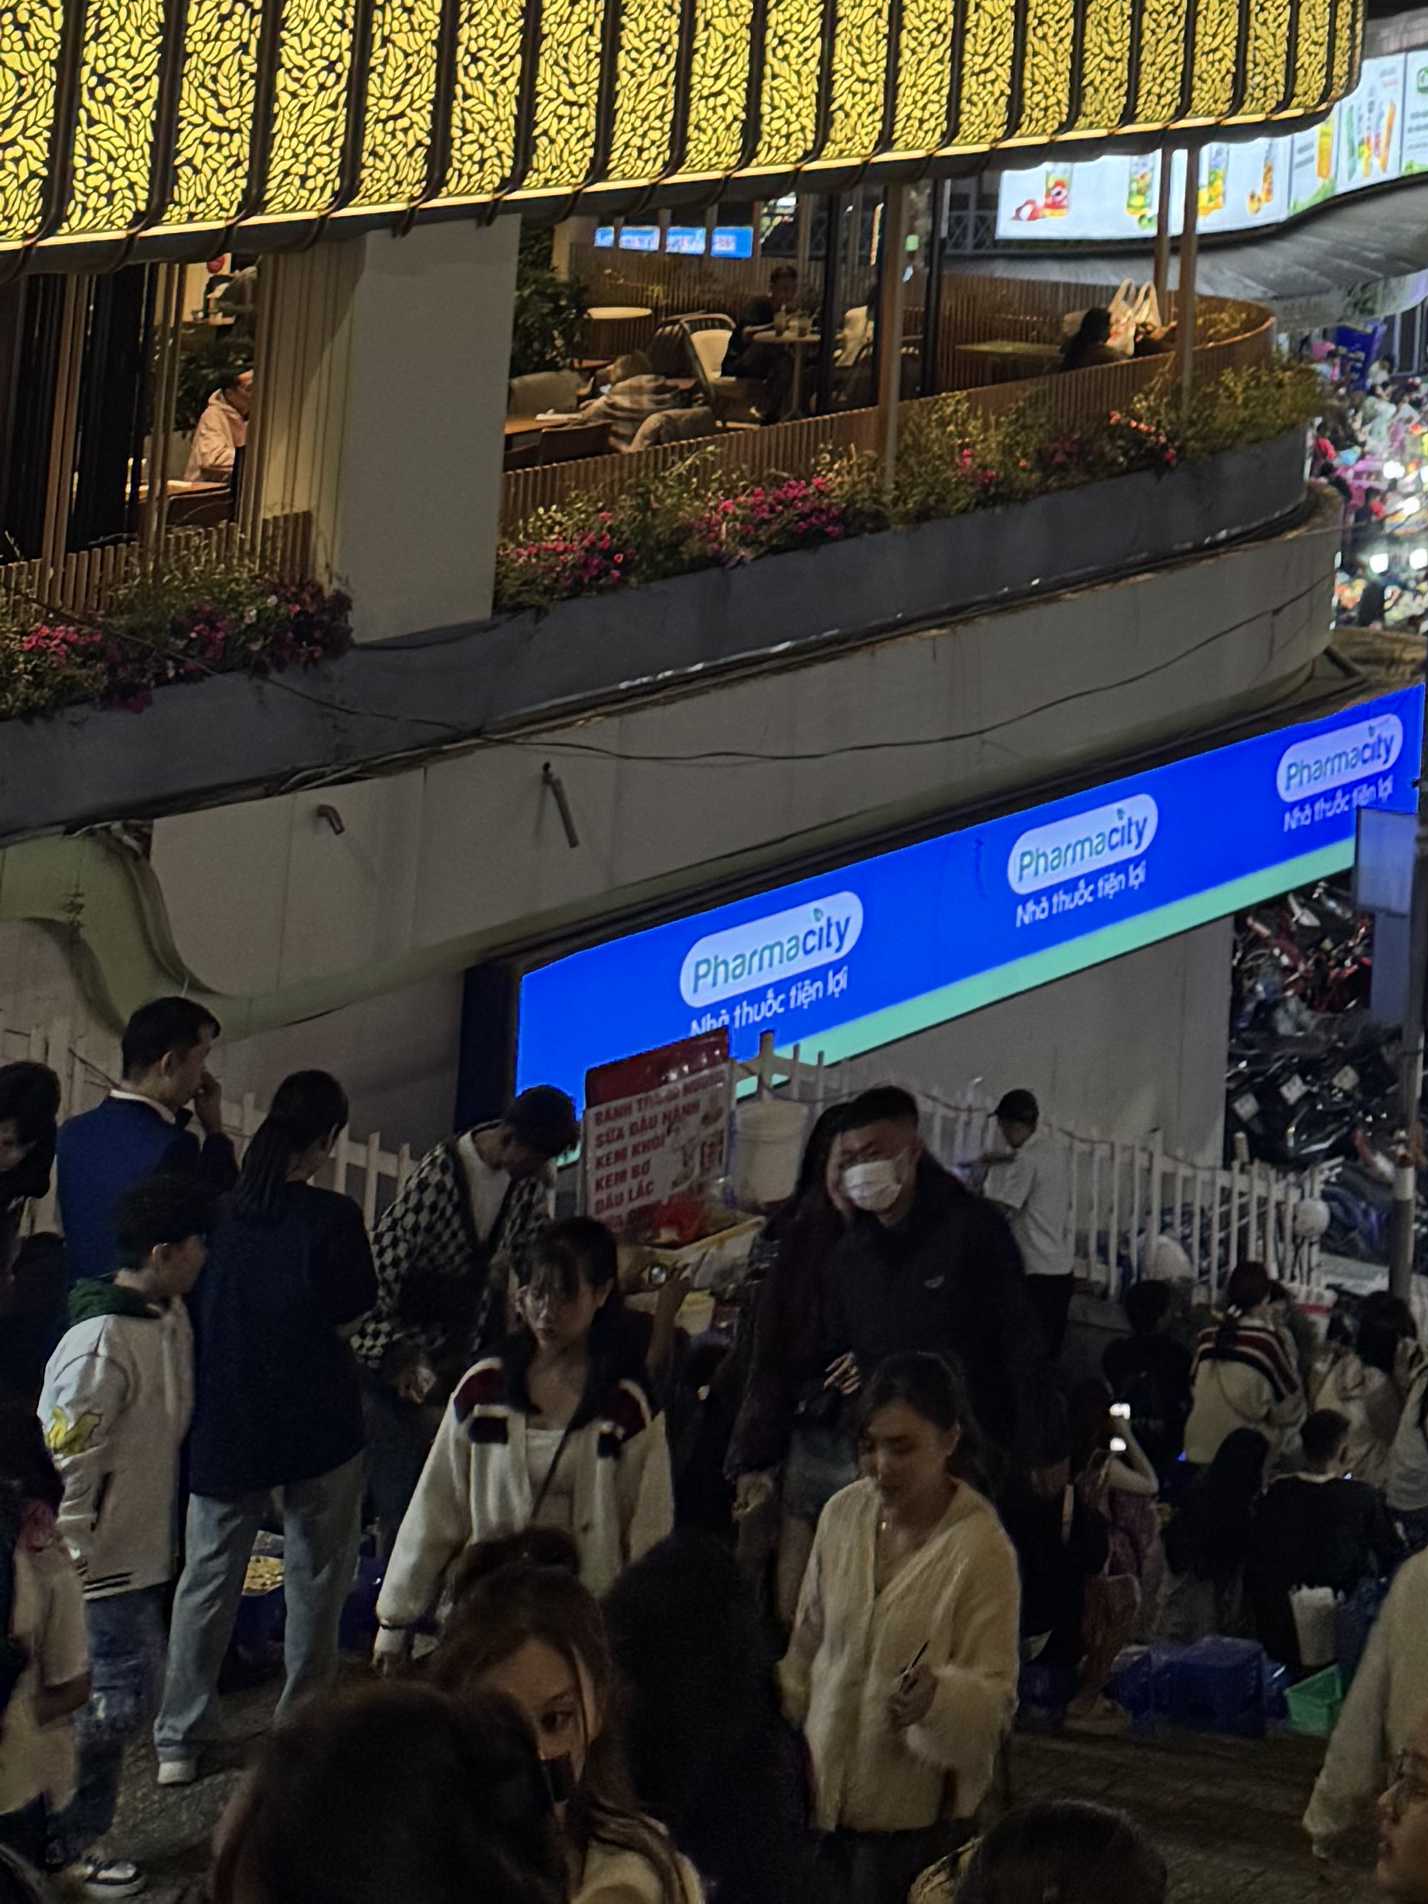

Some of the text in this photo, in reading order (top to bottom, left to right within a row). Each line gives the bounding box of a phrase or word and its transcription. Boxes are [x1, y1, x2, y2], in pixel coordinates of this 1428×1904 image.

[1284, 724, 1395, 792] Pharmacity
[1017, 807, 1148, 883] Pharmacity
[691, 908, 851, 995] Pharmacity
[733, 987, 785, 1029] thuốc
[789, 980, 824, 1009] tiện
[827, 965, 848, 999] lợi
[594, 1169, 628, 1193] KEM
